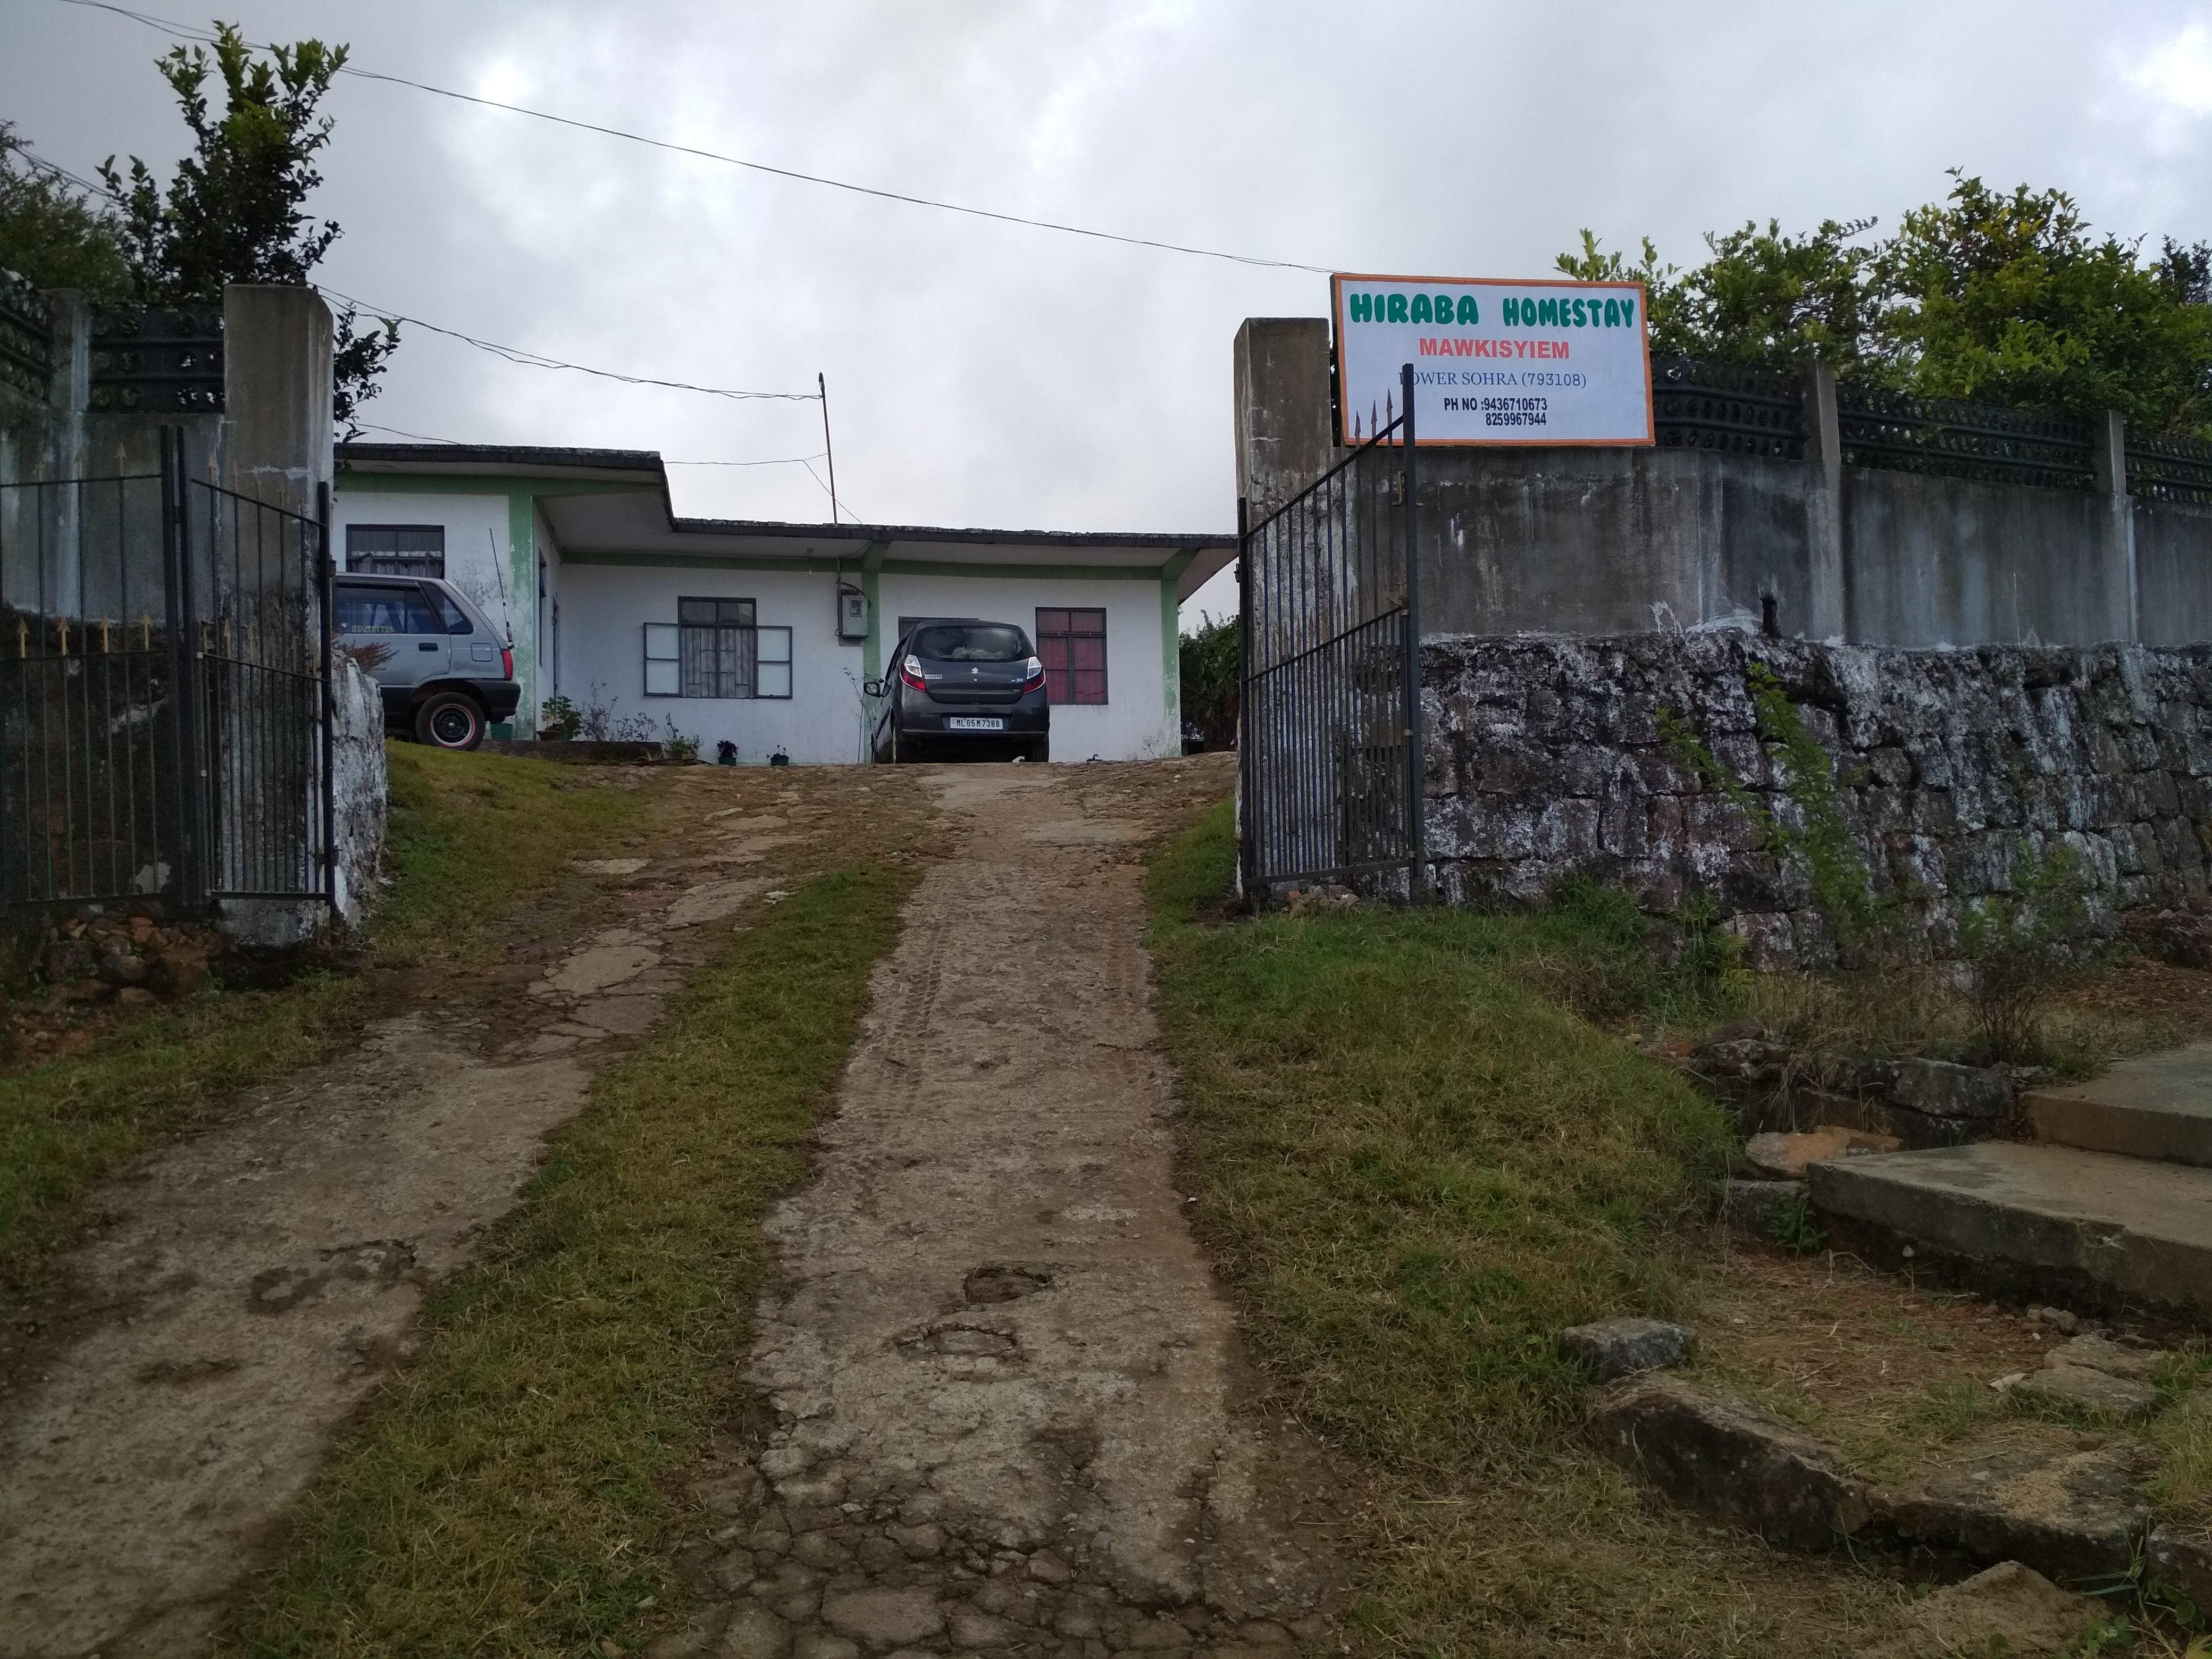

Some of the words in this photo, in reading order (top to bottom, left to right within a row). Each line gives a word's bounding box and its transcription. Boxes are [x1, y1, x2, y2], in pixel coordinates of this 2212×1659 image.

[1350, 294, 1480, 325] HIRABA
[1503, 297, 1635, 328] HOMESTAY
[1419, 338, 1570, 359] MAWKISYIEM
[1462, 373, 1518, 386] SOHRA
[1522, 373, 1587, 389] (793108)
[1444, 398, 1459, 411] PH
[1462, 398, 1478, 411] NO
[1486, 413, 1547, 426] 8259967944
